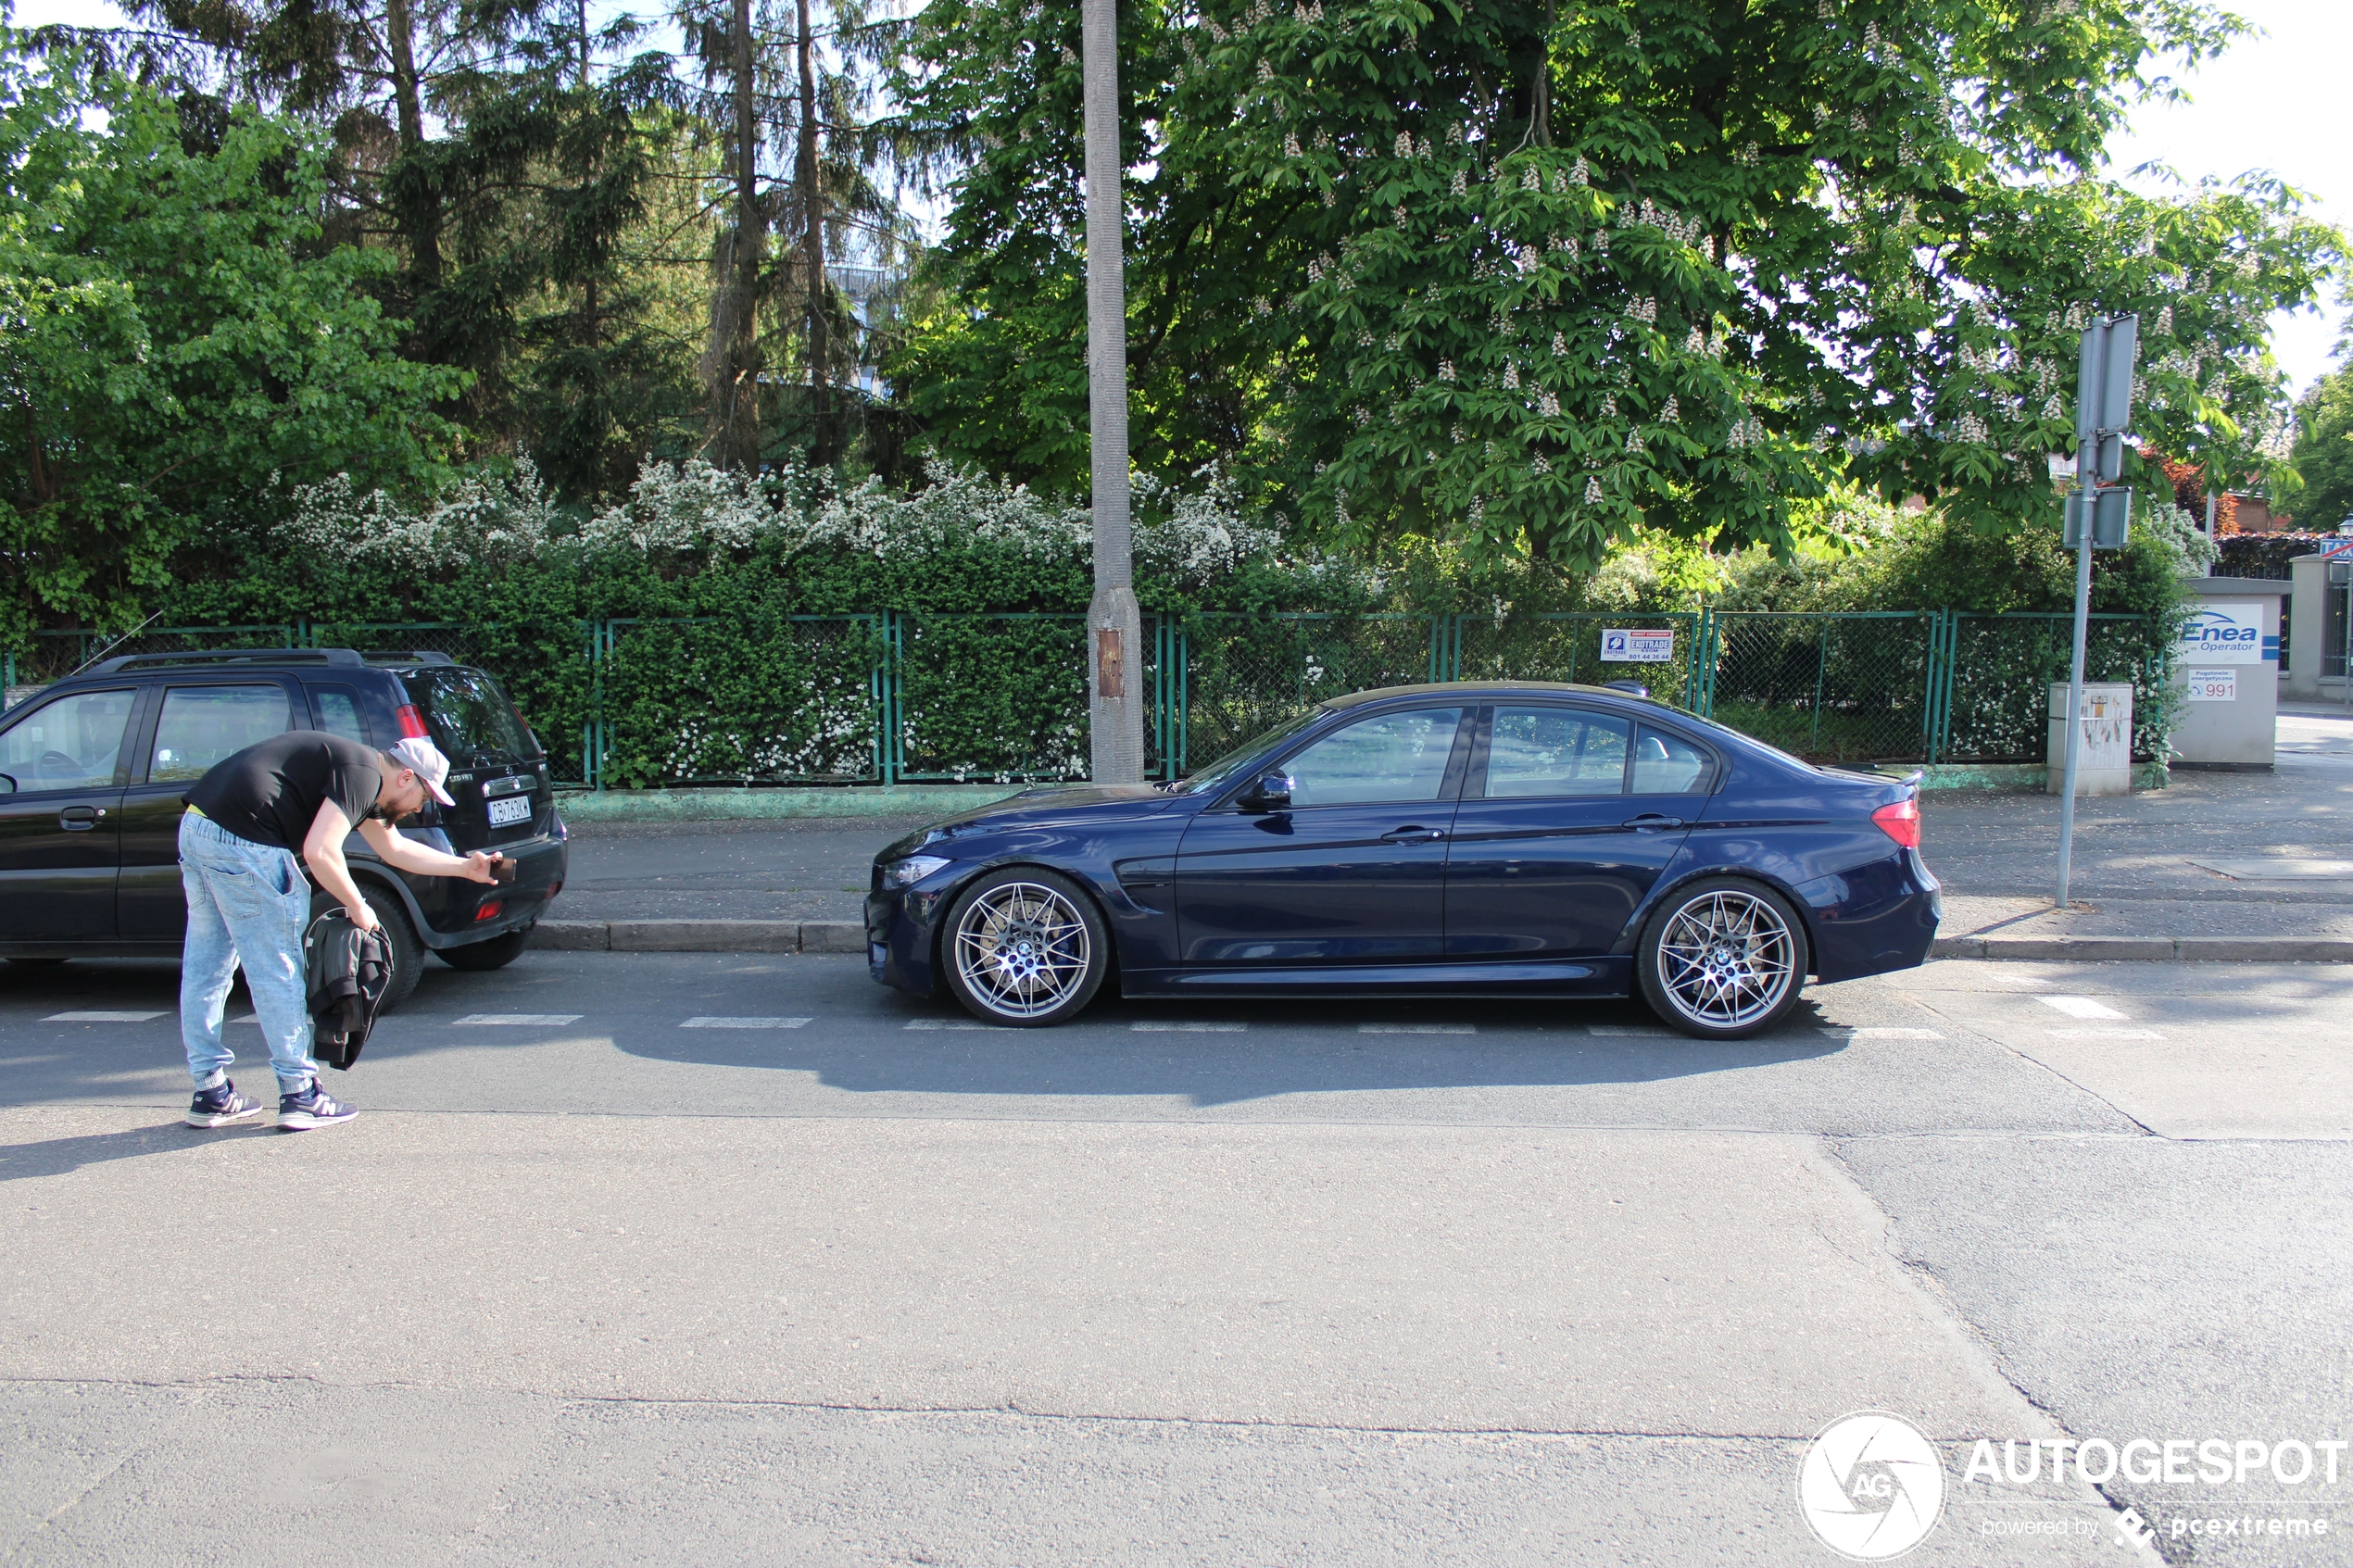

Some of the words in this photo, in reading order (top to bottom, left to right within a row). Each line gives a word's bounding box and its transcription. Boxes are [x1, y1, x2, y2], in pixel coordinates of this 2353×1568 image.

[2183, 623, 2257, 641] Enea
[1631, 640, 1668, 648] EKOTRADE
[2200, 642, 2254, 652] Operator
[2206, 684, 2233, 696] 991
[493, 803, 504, 822] CB
[231, 1098, 244, 1113] N
[321, 1101, 336, 1115] N
